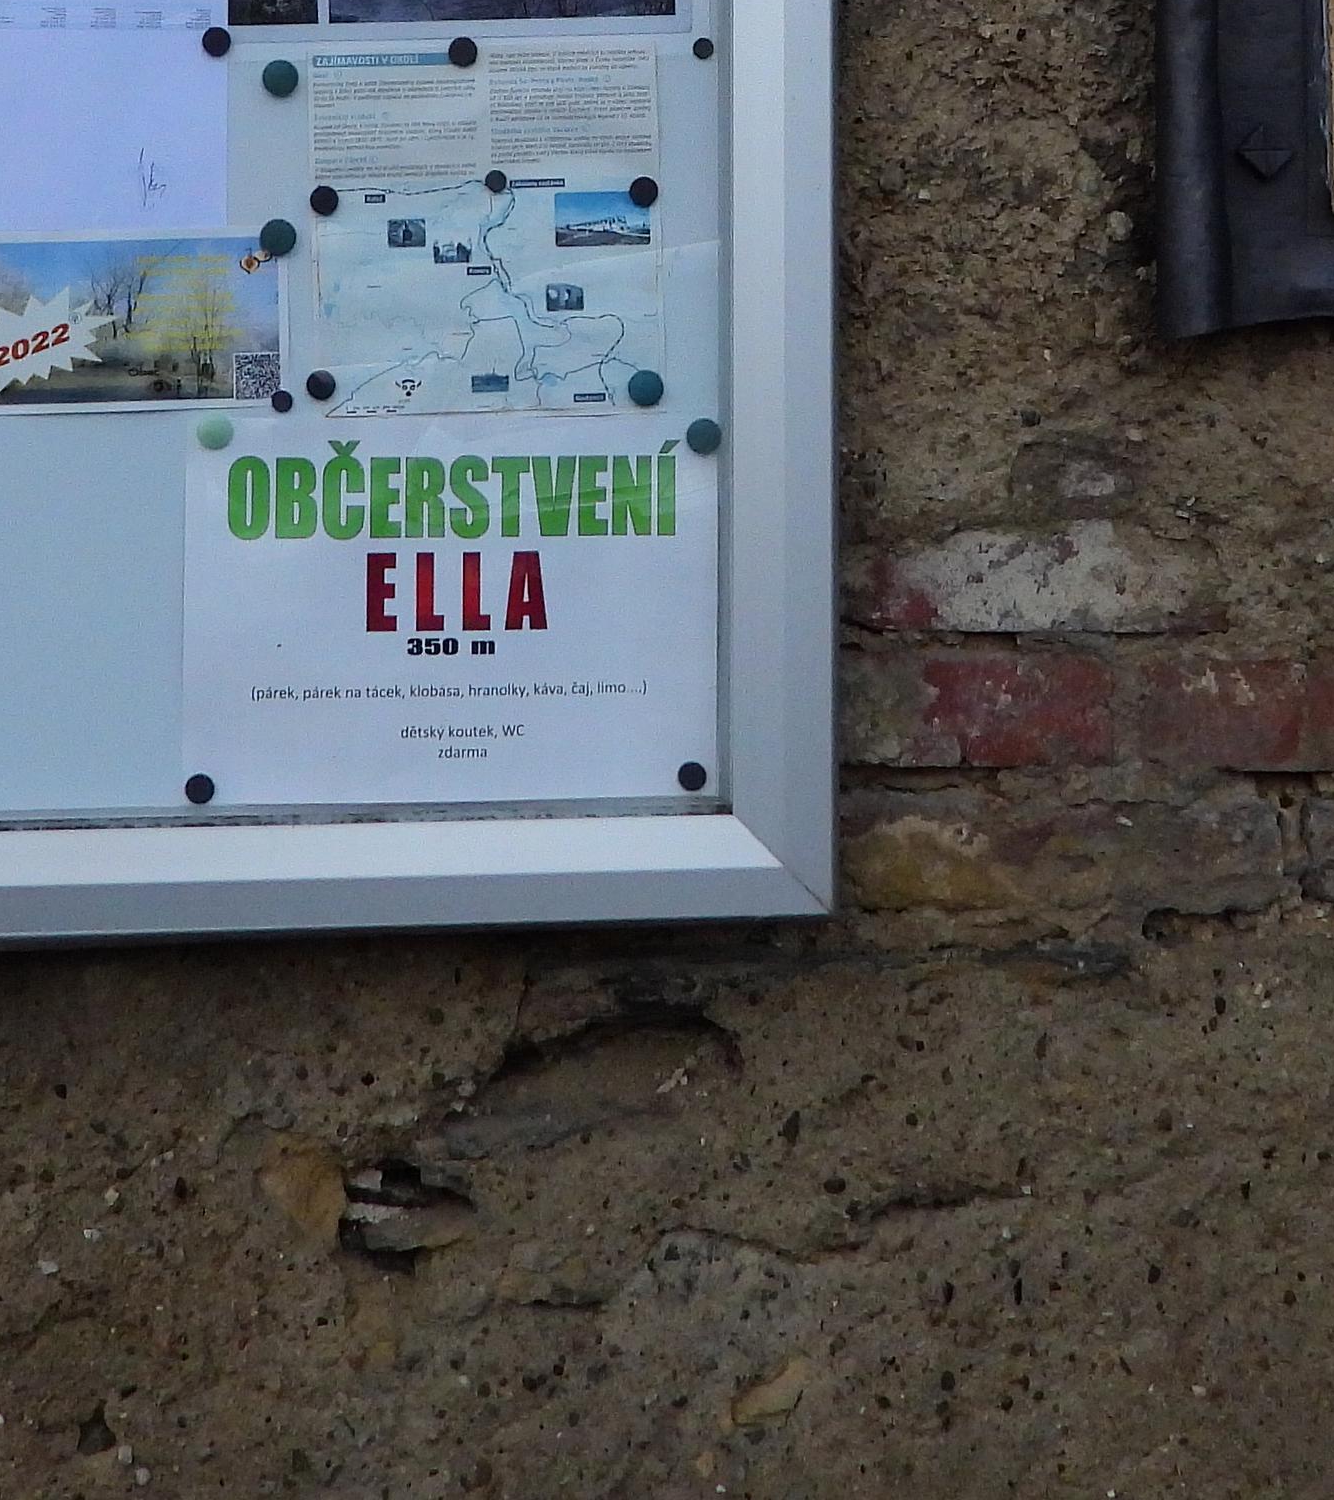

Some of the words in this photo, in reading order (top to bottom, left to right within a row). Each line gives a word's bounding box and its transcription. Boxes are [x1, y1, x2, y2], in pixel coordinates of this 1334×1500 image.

[316, 55, 379, 67] ZAJÍMAVOSTI
[381, 55, 389, 65] V
[227, 439, 680, 540] OBČERSTVENÍ
[366, 551, 548, 632] ELLA
[406, 637, 459, 656] 350
[471, 640, 496, 655] m
[250, 685, 299, 702] (párek,
[303, 686, 341, 701] párek
[345, 688, 362, 699] na
[366, 685, 406, 700] tácek,
[409, 683, 465, 700] klobása,
[468, 683, 529, 699] hranolky,
[533, 682, 567, 697] káva,
[571, 681, 593, 696] čaj,
[400, 725, 446, 740] dětský
[448, 724, 498, 739] koutek,
[502, 724, 525, 737] WC
[438, 746, 488, 759] zdarma
